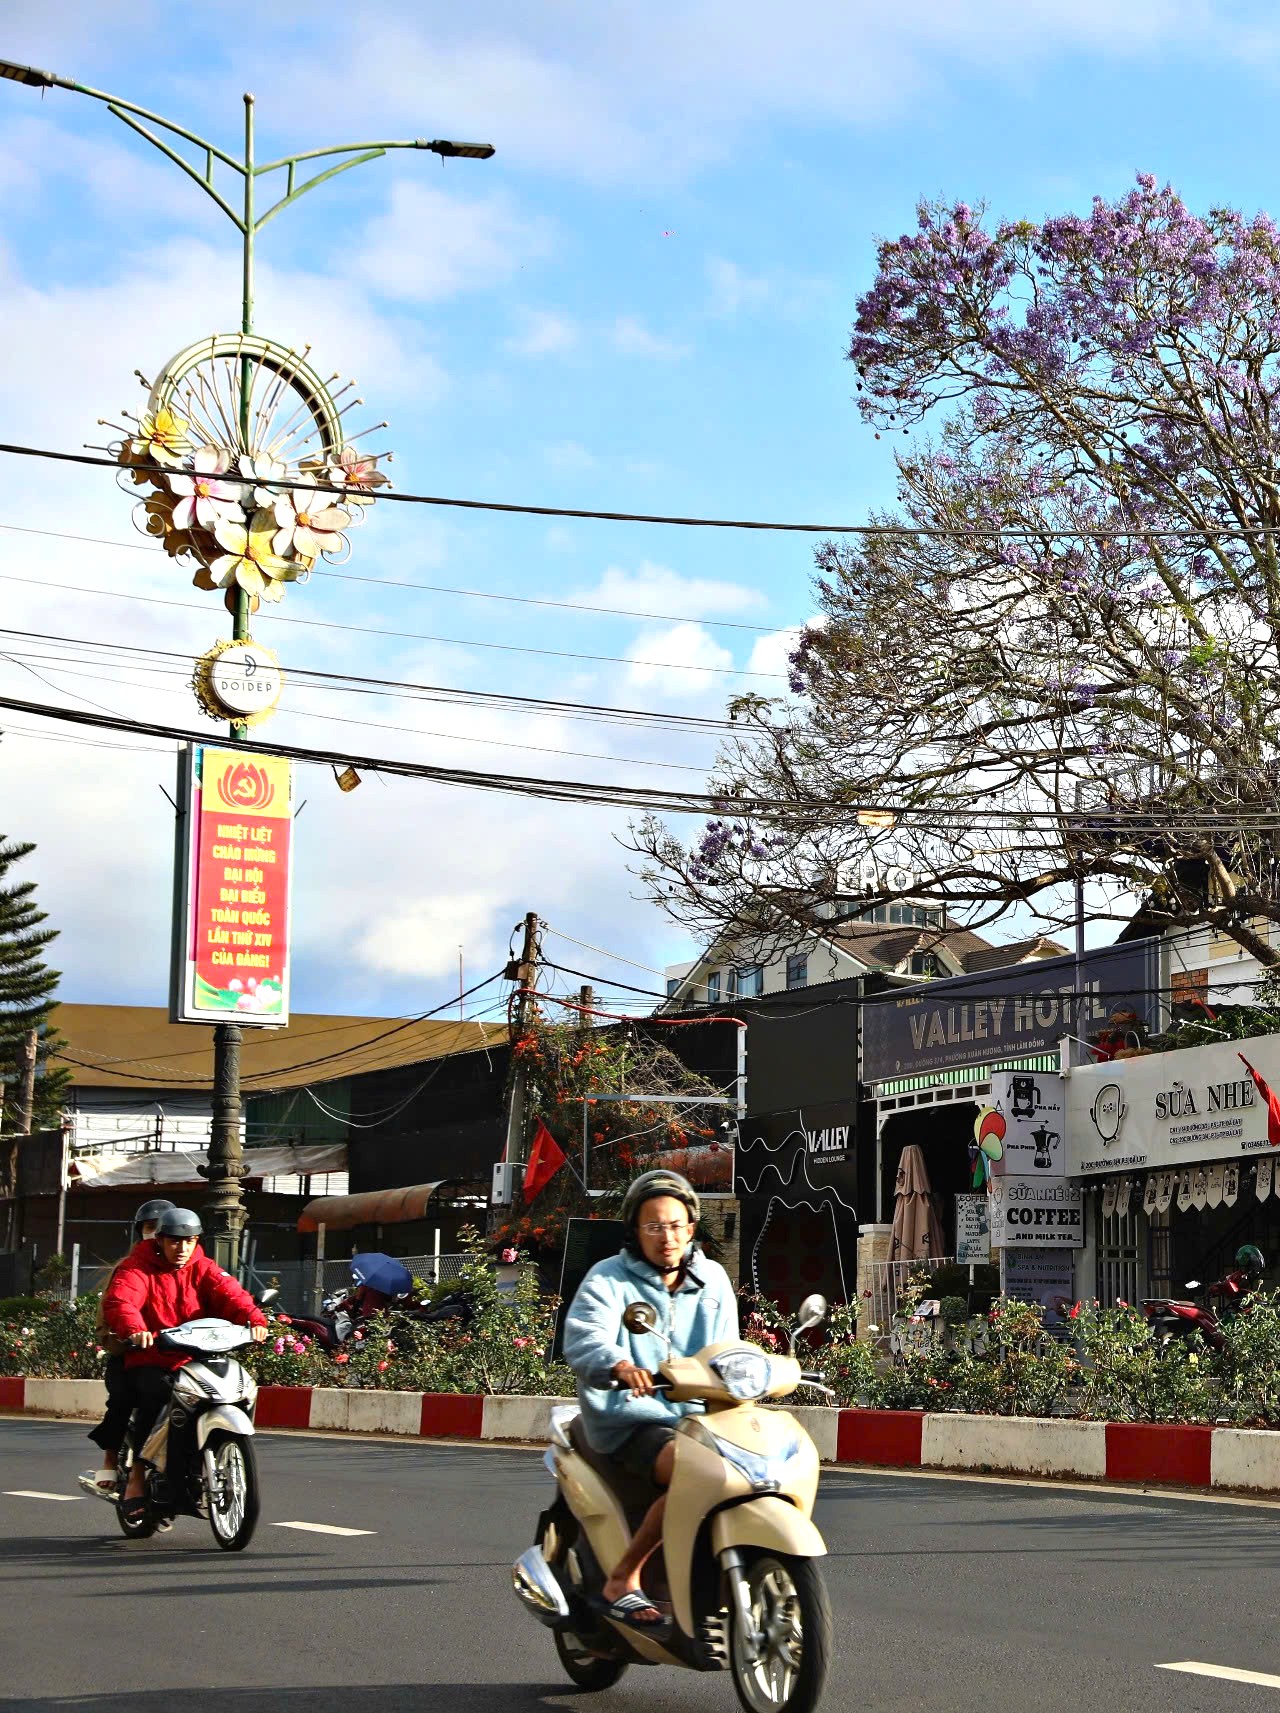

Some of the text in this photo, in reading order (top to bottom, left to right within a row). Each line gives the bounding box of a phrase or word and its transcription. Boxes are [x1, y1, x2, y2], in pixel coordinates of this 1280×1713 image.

[221, 681, 272, 692] DOIDEP
[217, 824, 272, 844] NHIỆT LIỆT
[212, 844, 242, 860] CHÀO
[211, 907, 270, 926] TOÀN QUỐC
[254, 933, 272, 947] XIV
[211, 947, 234, 966] CỦA
[909, 997, 1006, 1050] VALLEY
[807, 1126, 849, 1152] VALLEY
[1008, 1183, 1036, 1201] SỮA
[1007, 1207, 1081, 1226] COFFEE
[1035, 1233, 1056, 1241] MILK
[1037, 1264, 1070, 1272] NUTRITION
